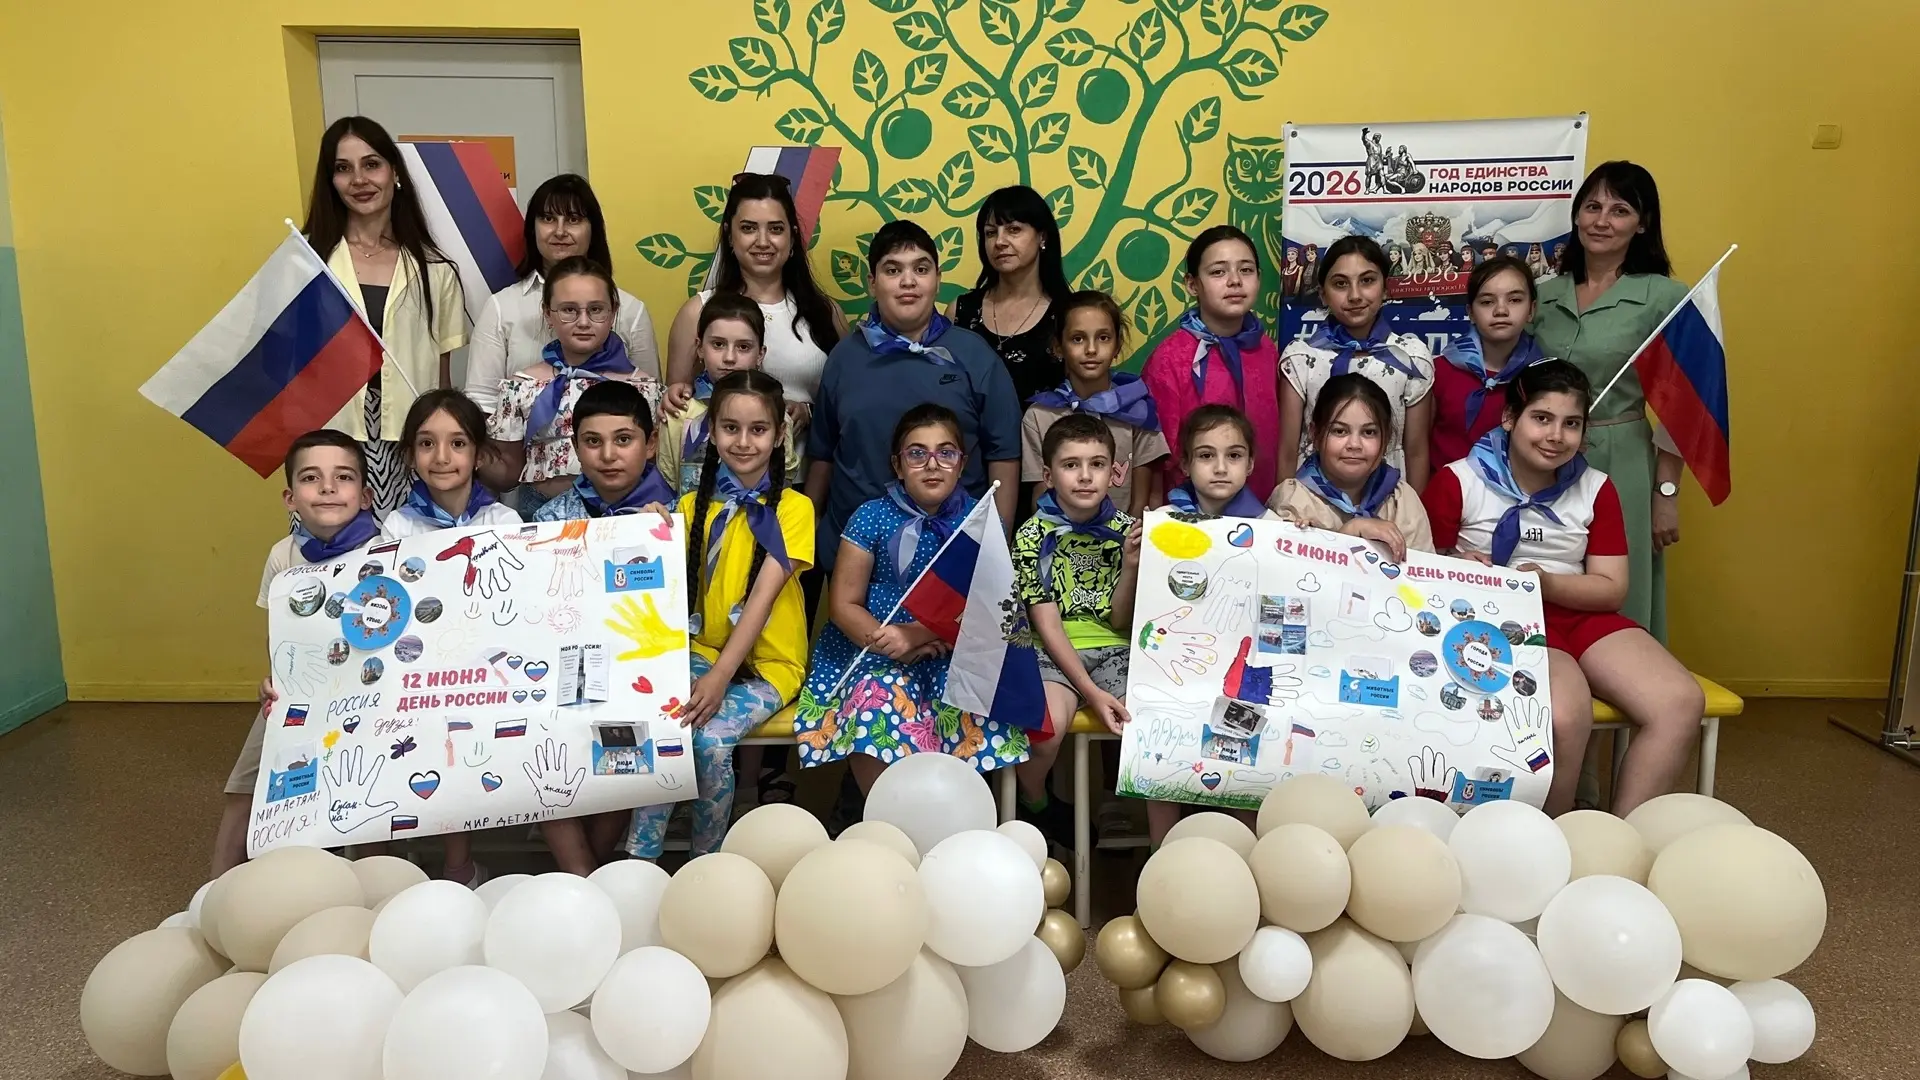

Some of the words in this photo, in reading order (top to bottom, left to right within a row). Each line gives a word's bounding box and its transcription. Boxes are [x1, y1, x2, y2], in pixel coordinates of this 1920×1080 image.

[1289, 170, 1361, 196] 2026
[1429, 168, 1460, 180] ГОД
[1465, 165, 1549, 179] ЕДИНСТВА
[1429, 181, 1503, 194] НАРОДОВ
[1507, 179, 1573, 192] РОССИИ
[1398, 263, 1459, 286] 2026
[1275, 537, 1293, 554] 12
[1297, 543, 1349, 567] ИЮНЯ
[1407, 566, 1445, 579] ДЕНЬ
[1447, 571, 1502, 588] РОССИИ
[402, 673, 422, 689] 12
[427, 667, 487, 688] ИЮНЯ
[396, 694, 441, 713] ДЕНЬ
[445, 691, 508, 708] РОССИИ
[256, 805, 281, 826] МИР
[464, 817, 490, 830] МИР
